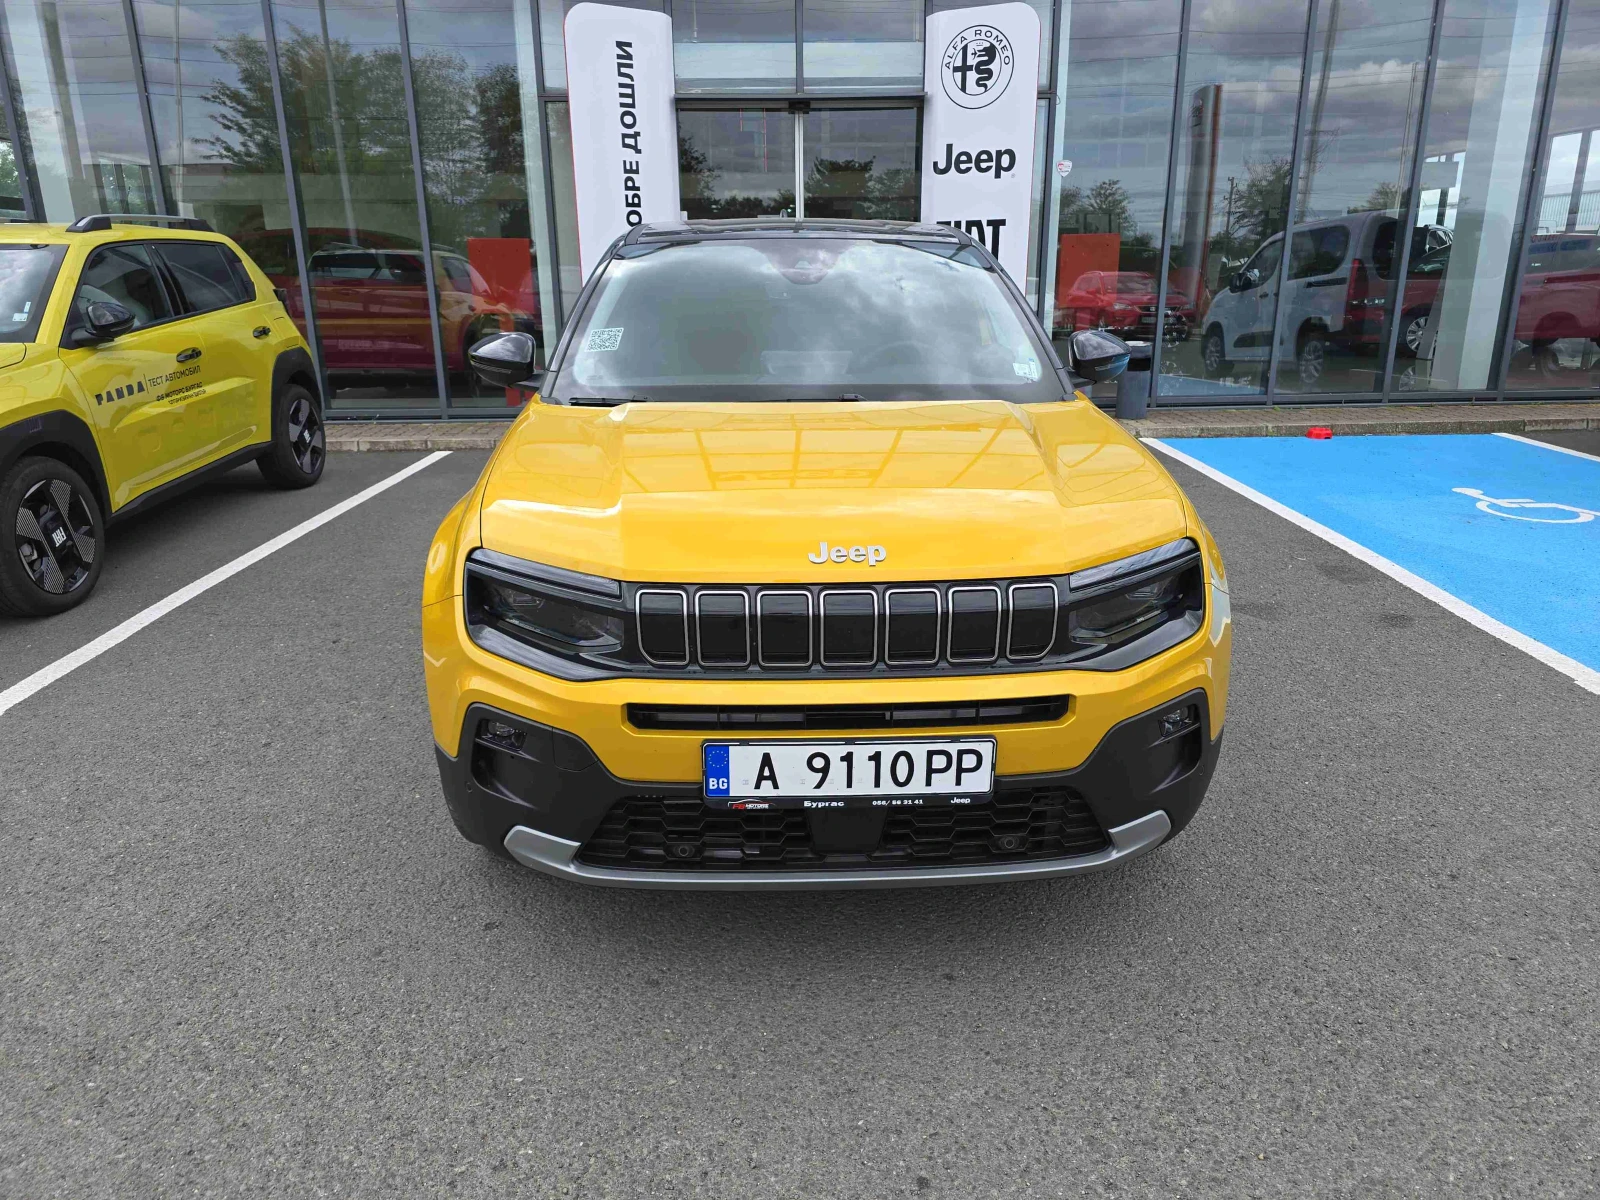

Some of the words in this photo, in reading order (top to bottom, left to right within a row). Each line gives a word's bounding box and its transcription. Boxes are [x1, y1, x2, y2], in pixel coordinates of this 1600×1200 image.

[944, 34, 969, 71] ALFA
[973, 28, 1011, 67] ROMEO
[615, 39, 643, 156] ДОШЛИ
[932, 143, 1016, 179] Jeep
[622, 159, 643, 228] ОБРЕ
[147, 376, 164, 388] ТЕСТ
[165, 365, 201, 382] АВТОМОБИЛ
[94, 380, 146, 406] PANDA
[164, 387, 186, 400] МОТОРС
[184, 381, 203, 394] БУРГАС
[807, 541, 887, 567] Jeep
[753, 752, 780, 790] A
[806, 750, 915, 790] 9110
[925, 749, 984, 787] PP
[708, 778, 728, 790] BG
[803, 800, 845, 808] Бургас
[950, 796, 971, 804] Jeep
